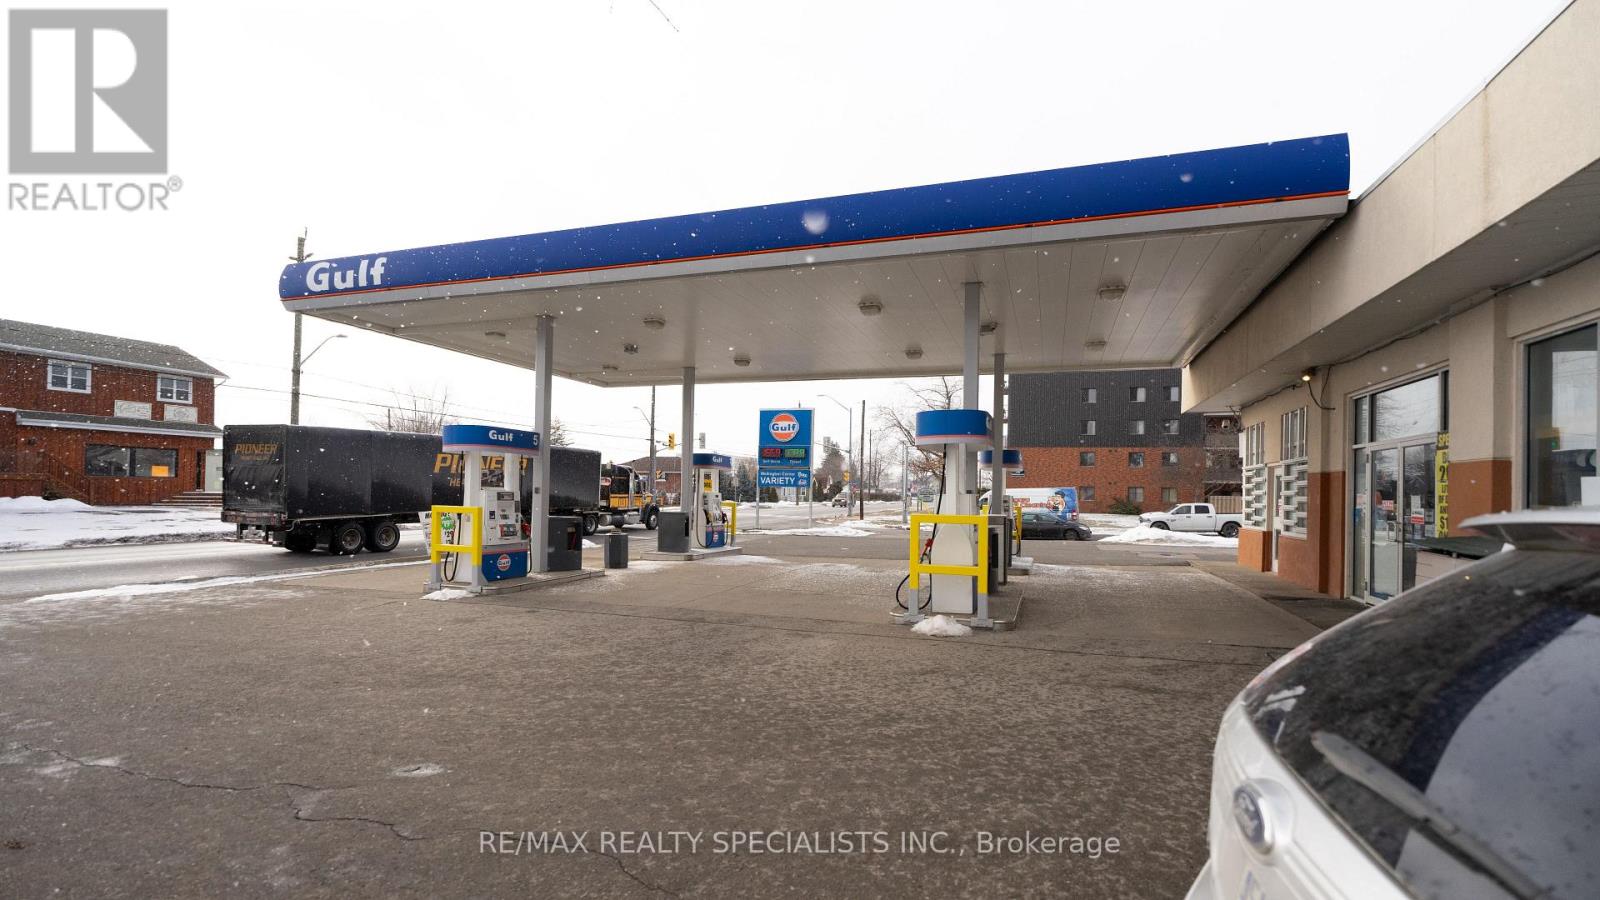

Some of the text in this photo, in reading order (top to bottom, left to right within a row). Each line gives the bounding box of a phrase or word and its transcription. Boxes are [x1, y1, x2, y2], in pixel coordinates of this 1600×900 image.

[306, 257, 388, 292] Gulf
[771, 423, 797, 432] Gulf
[489, 430, 514, 442] Gulf
[235, 443, 278, 454] PIONEER
[760, 476, 796, 485] VARIETY
